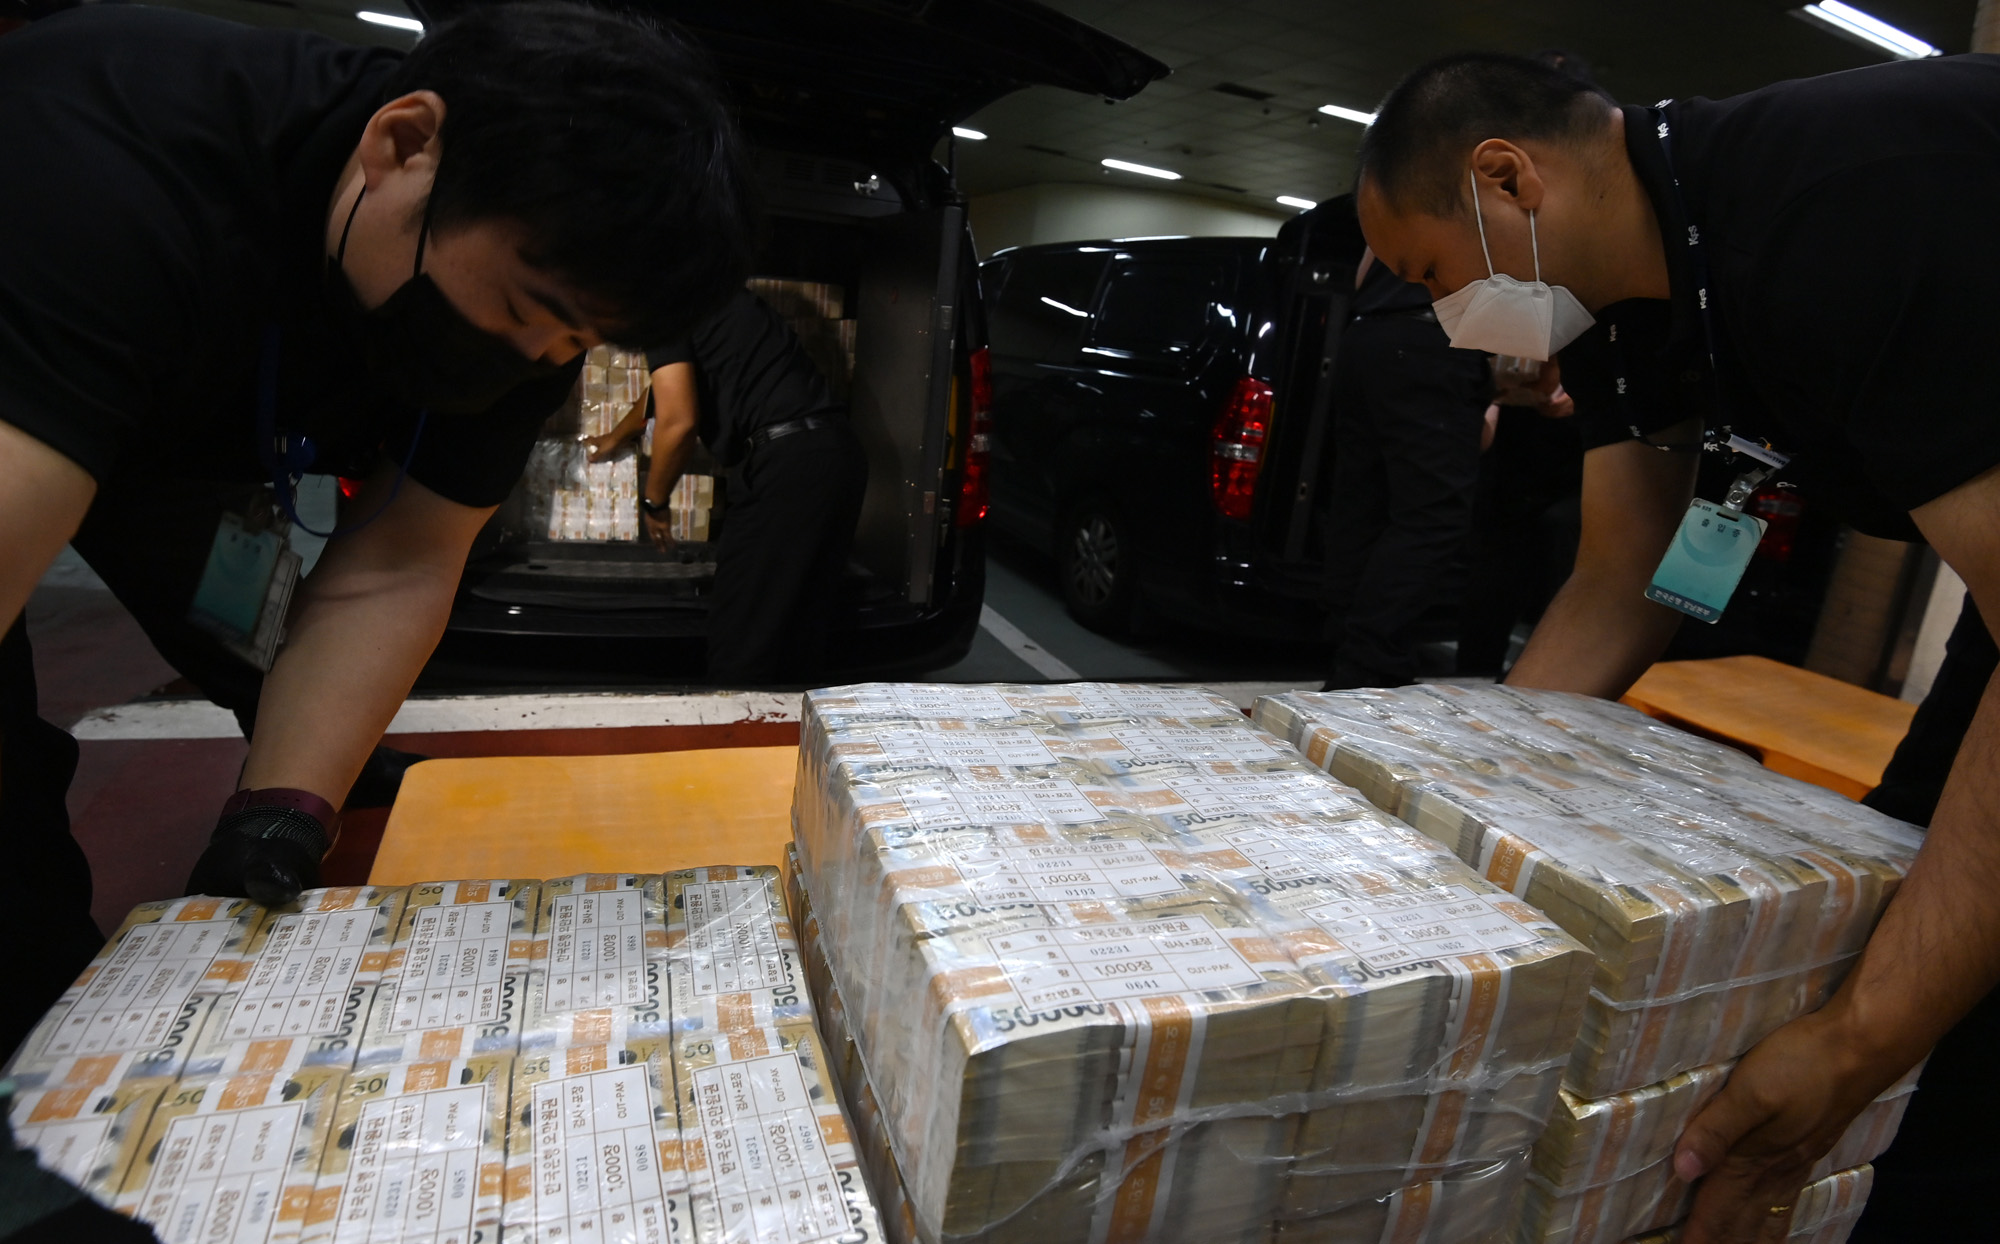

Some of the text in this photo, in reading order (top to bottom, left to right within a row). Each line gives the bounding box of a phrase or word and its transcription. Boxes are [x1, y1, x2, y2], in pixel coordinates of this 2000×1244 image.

[1028, 846, 1077, 856] 한국은행
[1035, 860, 1073, 868] 02231
[1038, 872, 1093, 884] 1,000장
[1063, 887, 1096, 896] 0103
[1118, 875, 1163, 884] CUT-PAK
[481, 910, 492, 933] CUT-PAK
[616, 898, 624, 920] CUT-PAK
[338, 917, 356, 941] CUT-PAK
[555, 904, 573, 962] 한국은행 오만원권
[1077, 921, 1191, 940] 한국은행 오만원권
[253, 925, 295, 985] 한국은행 오만원권
[487, 949, 498, 966] 0664
[581, 939, 591, 960] 02231
[603, 933, 616, 961] 1,000장
[1088, 944, 1132, 956] 02231
[282, 962, 301, 983] 02231
[305, 955, 332, 986] 1,000장
[409, 947, 430, 977] 한국은행
[436, 953, 450, 975] 02231
[459, 947, 478, 977] 1,000장
[1092, 959, 1156, 976] 1,000장
[1185, 963, 1234, 974] CUT-PAK
[627, 969, 638, 999] 포장번호
[1123, 979, 1161, 991] 0641
[479, 986, 493, 1017] 포장번호
[768, 1067, 786, 1101] CUT-PAK
[613, 1080, 628, 1119] CUT-PAK
[702, 1082, 736, 1174] 한국은행 오만원권
[798, 1123, 815, 1150] 0667
[541, 1096, 561, 1195] 한국은행 오만원권
[743, 1135, 763, 1169] 02231
[346, 1116, 386, 1221] 한국은행 오만원권
[575, 1155, 590, 1190] 02231
[602, 1143, 625, 1191] 1,000장
[381, 1179, 403, 1218] 02231
[413, 1166, 439, 1220] 1,000장
